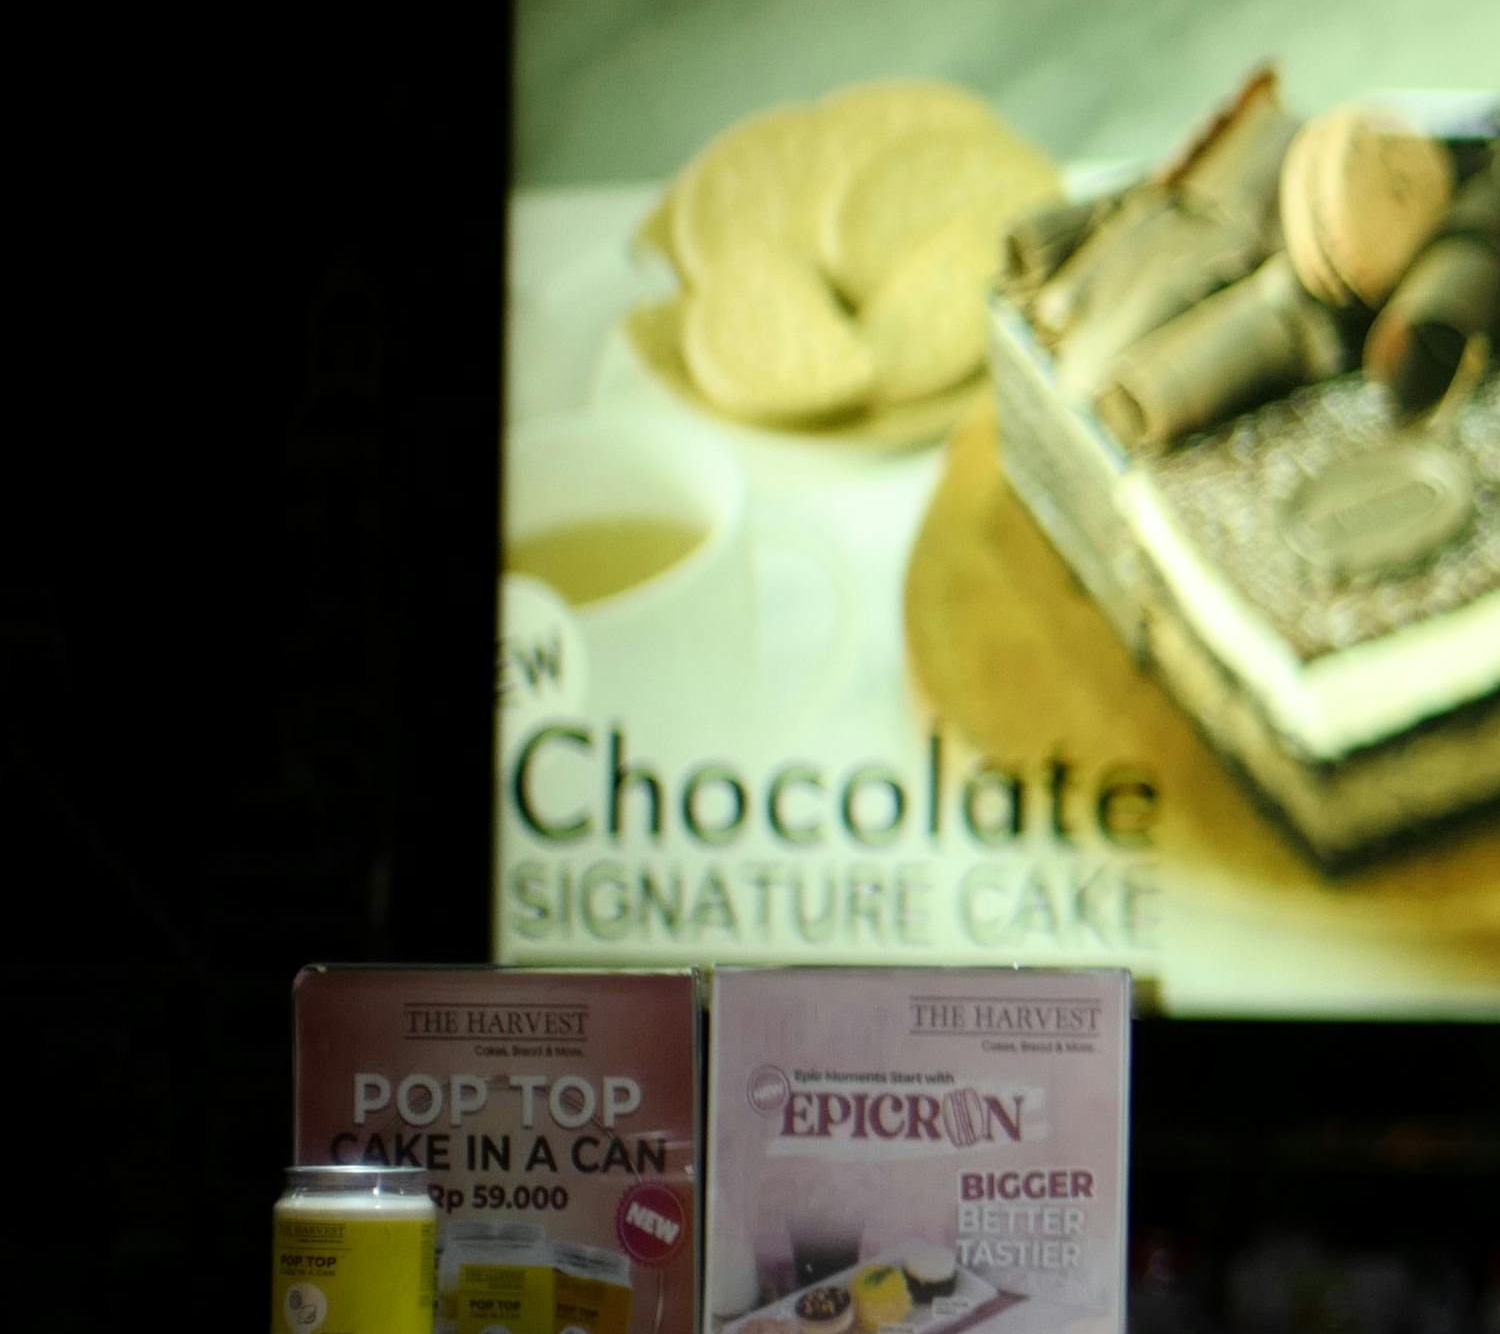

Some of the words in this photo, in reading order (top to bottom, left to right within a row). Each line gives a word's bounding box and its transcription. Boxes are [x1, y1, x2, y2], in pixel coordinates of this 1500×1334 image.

[513, 720, 1159, 848] Chocolate
[512, 863, 932, 945] SIGNATURE
[959, 861, 1162, 947] CAKE
[405, 1009, 460, 1035] THE
[467, 1009, 589, 1036] HARVEST
[913, 1004, 966, 1029] THE
[974, 1005, 1101, 1031] HARVEST
[825, 1070, 887, 1083] Moments
[924, 1071, 954, 1084] with
[353, 1072, 488, 1128] POP
[509, 1074, 643, 1130] TOP
[331, 1131, 450, 1171] CAKE
[466, 1134, 510, 1171] IN
[525, 1134, 558, 1173] A
[571, 1133, 667, 1175] CAN
[428, 1185, 463, 1214] Rp
[472, 1185, 568, 1211] 59.000
[960, 1170, 1094, 1201] BIGGER
[625, 1201, 681, 1246] NEW
[958, 1207, 1085, 1235] BETTER
[280, 1254, 303, 1267] POP
[307, 1255, 337, 1268] TOP
[957, 1239, 1082, 1267] TASTIER
